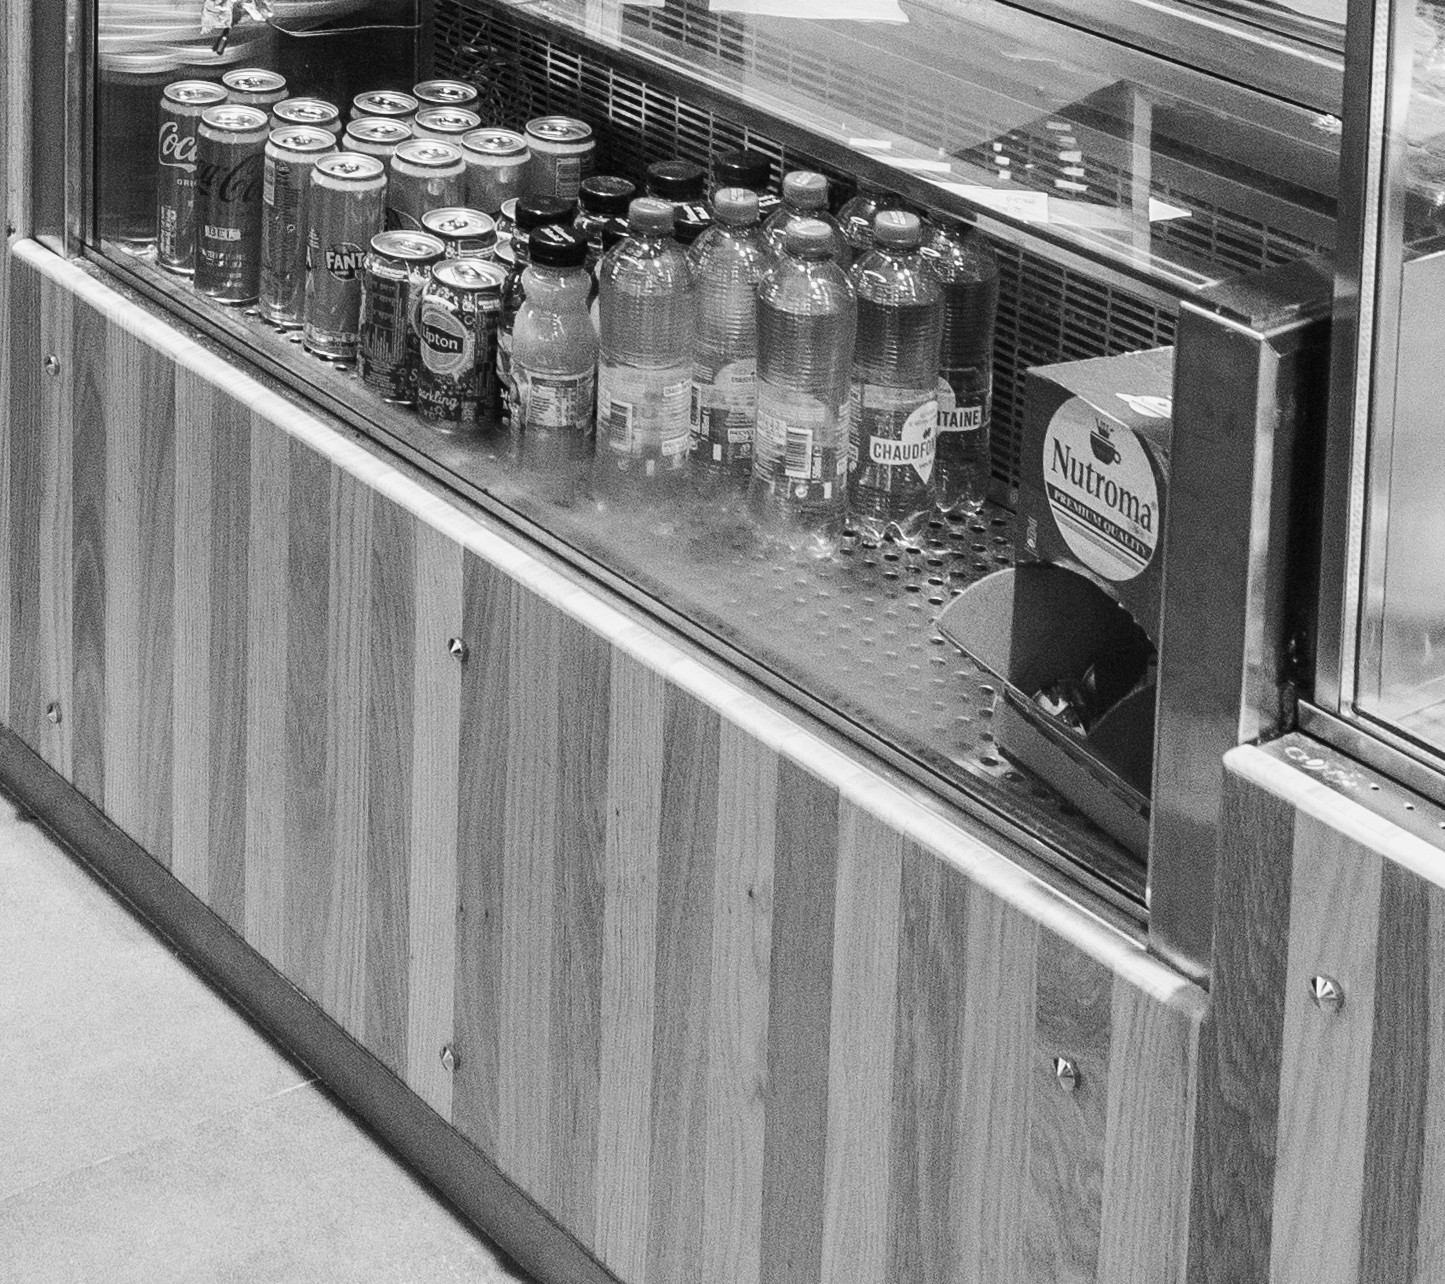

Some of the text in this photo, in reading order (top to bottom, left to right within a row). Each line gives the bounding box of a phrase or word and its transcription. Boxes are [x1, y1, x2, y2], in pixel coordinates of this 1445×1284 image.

[325, 251, 365, 270] FANT
[1050, 435, 1153, 535] Nutroma
[1053, 489, 1149, 556] PREMIUM QUALITY
